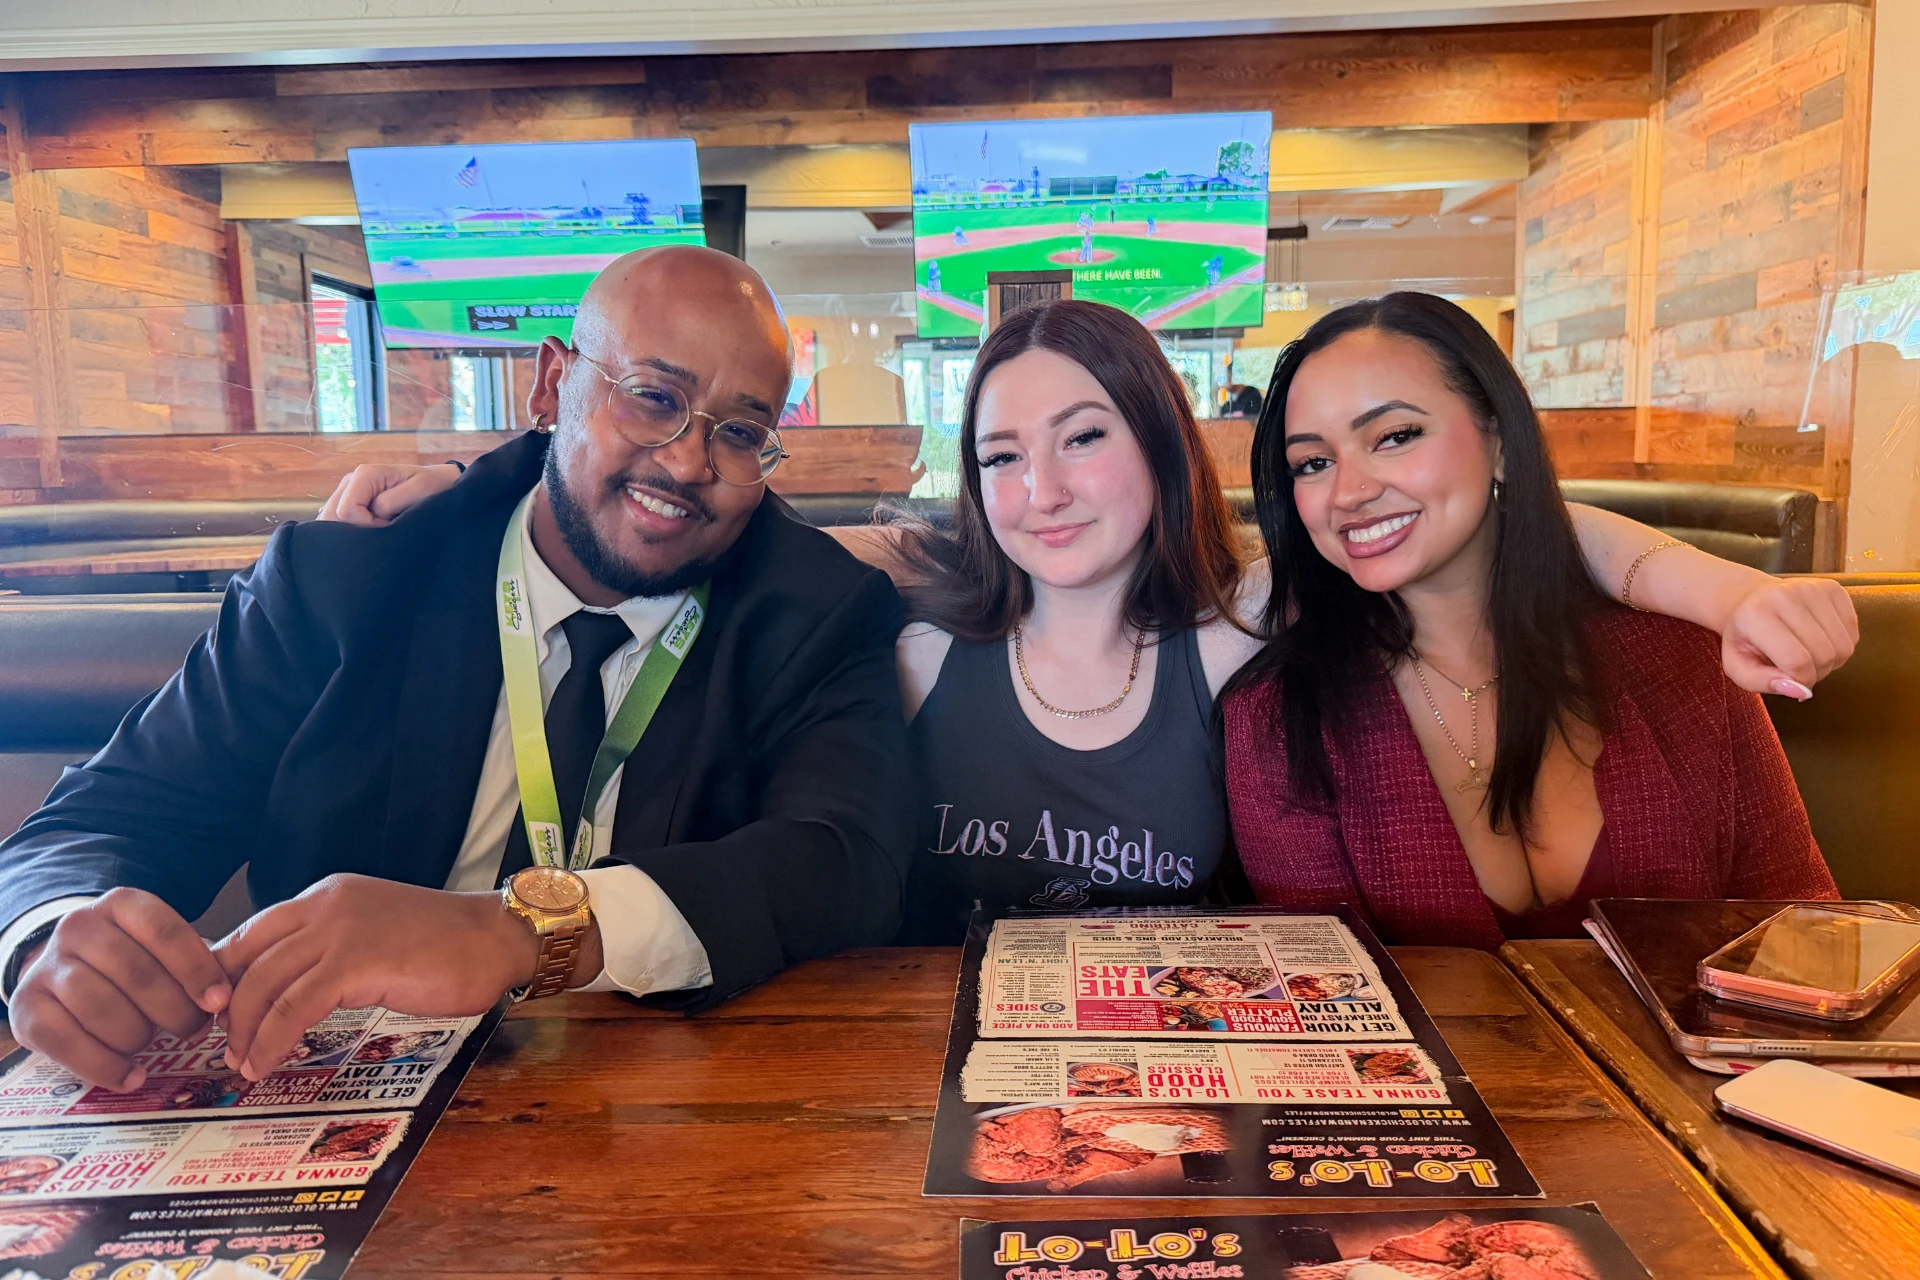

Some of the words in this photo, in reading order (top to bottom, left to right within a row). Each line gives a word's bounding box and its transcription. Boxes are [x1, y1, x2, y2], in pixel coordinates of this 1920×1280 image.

[1073, 270, 1102, 282] THERE
[1105, 269, 1132, 281] HAVE
[1133, 267, 1163, 280] BEEN.
[474, 305, 527, 318] SLOW
[529, 305, 580, 317] STAR
[928, 803, 1010, 856] Los
[1018, 810, 1194, 890] Angeles
[1081, 966, 1146, 978] EATS
[1079, 980, 1150, 996] THE
[1227, 1008, 1292, 1016] PLATTER
[1299, 1002, 1338, 1013] DAY
[1341, 1002, 1382, 1013] ALL
[1263, 1015, 1295, 1023] SOUL
[1232, 1023, 1300, 1032] FAMOUS
[1303, 1023, 1356, 1032] YOUR
[1356, 1022, 1397, 1032] GET
[334, 1065, 385, 1079] DAY
[390, 1063, 434, 1077] ALL
[1147, 1066, 1223, 1074] CLASSICS
[254, 1076, 328, 1088] PLATTER
[327, 1080, 349, 1089] ON
[350, 1076, 423, 1089] BREAKFAST
[1147, 1074, 1226, 1087] HOOD
[249, 1086, 285, 1095] FOOD
[288, 1085, 321, 1093] SOUL
[316, 1088, 373, 1101] YOUR
[374, 1086, 417, 1099] GET
[1148, 1087, 1229, 1098] LO-LO'S
[1256, 1088, 1295, 1098] YOU
[1302, 1088, 1367, 1098] TEASE
[1372, 1089, 1441, 1099] GONNA
[239, 1093, 314, 1106] FAMOUS
[78, 1151, 166, 1164] CLASSICS
[1267, 1144, 1354, 1159] Waffles
[1356, 1145, 1378, 1158] &
[1386, 1145, 1476, 1158] Chicken
[59, 1161, 156, 1180] HOOD
[217, 1169, 287, 1183] TEASE
[296, 1166, 369, 1180] GONNA
[43, 1178, 140, 1193] LO-LO'S
[166, 1174, 209, 1186] YOU
[129, 1202, 359, 1220] WWW.LOLOSCHICKENANDWAFFLES.COM
[1005, 1265, 1108, 1280] Chicken
[1116, 1264, 1143, 1280] &
[1147, 1260, 1244, 1279] Waffles
